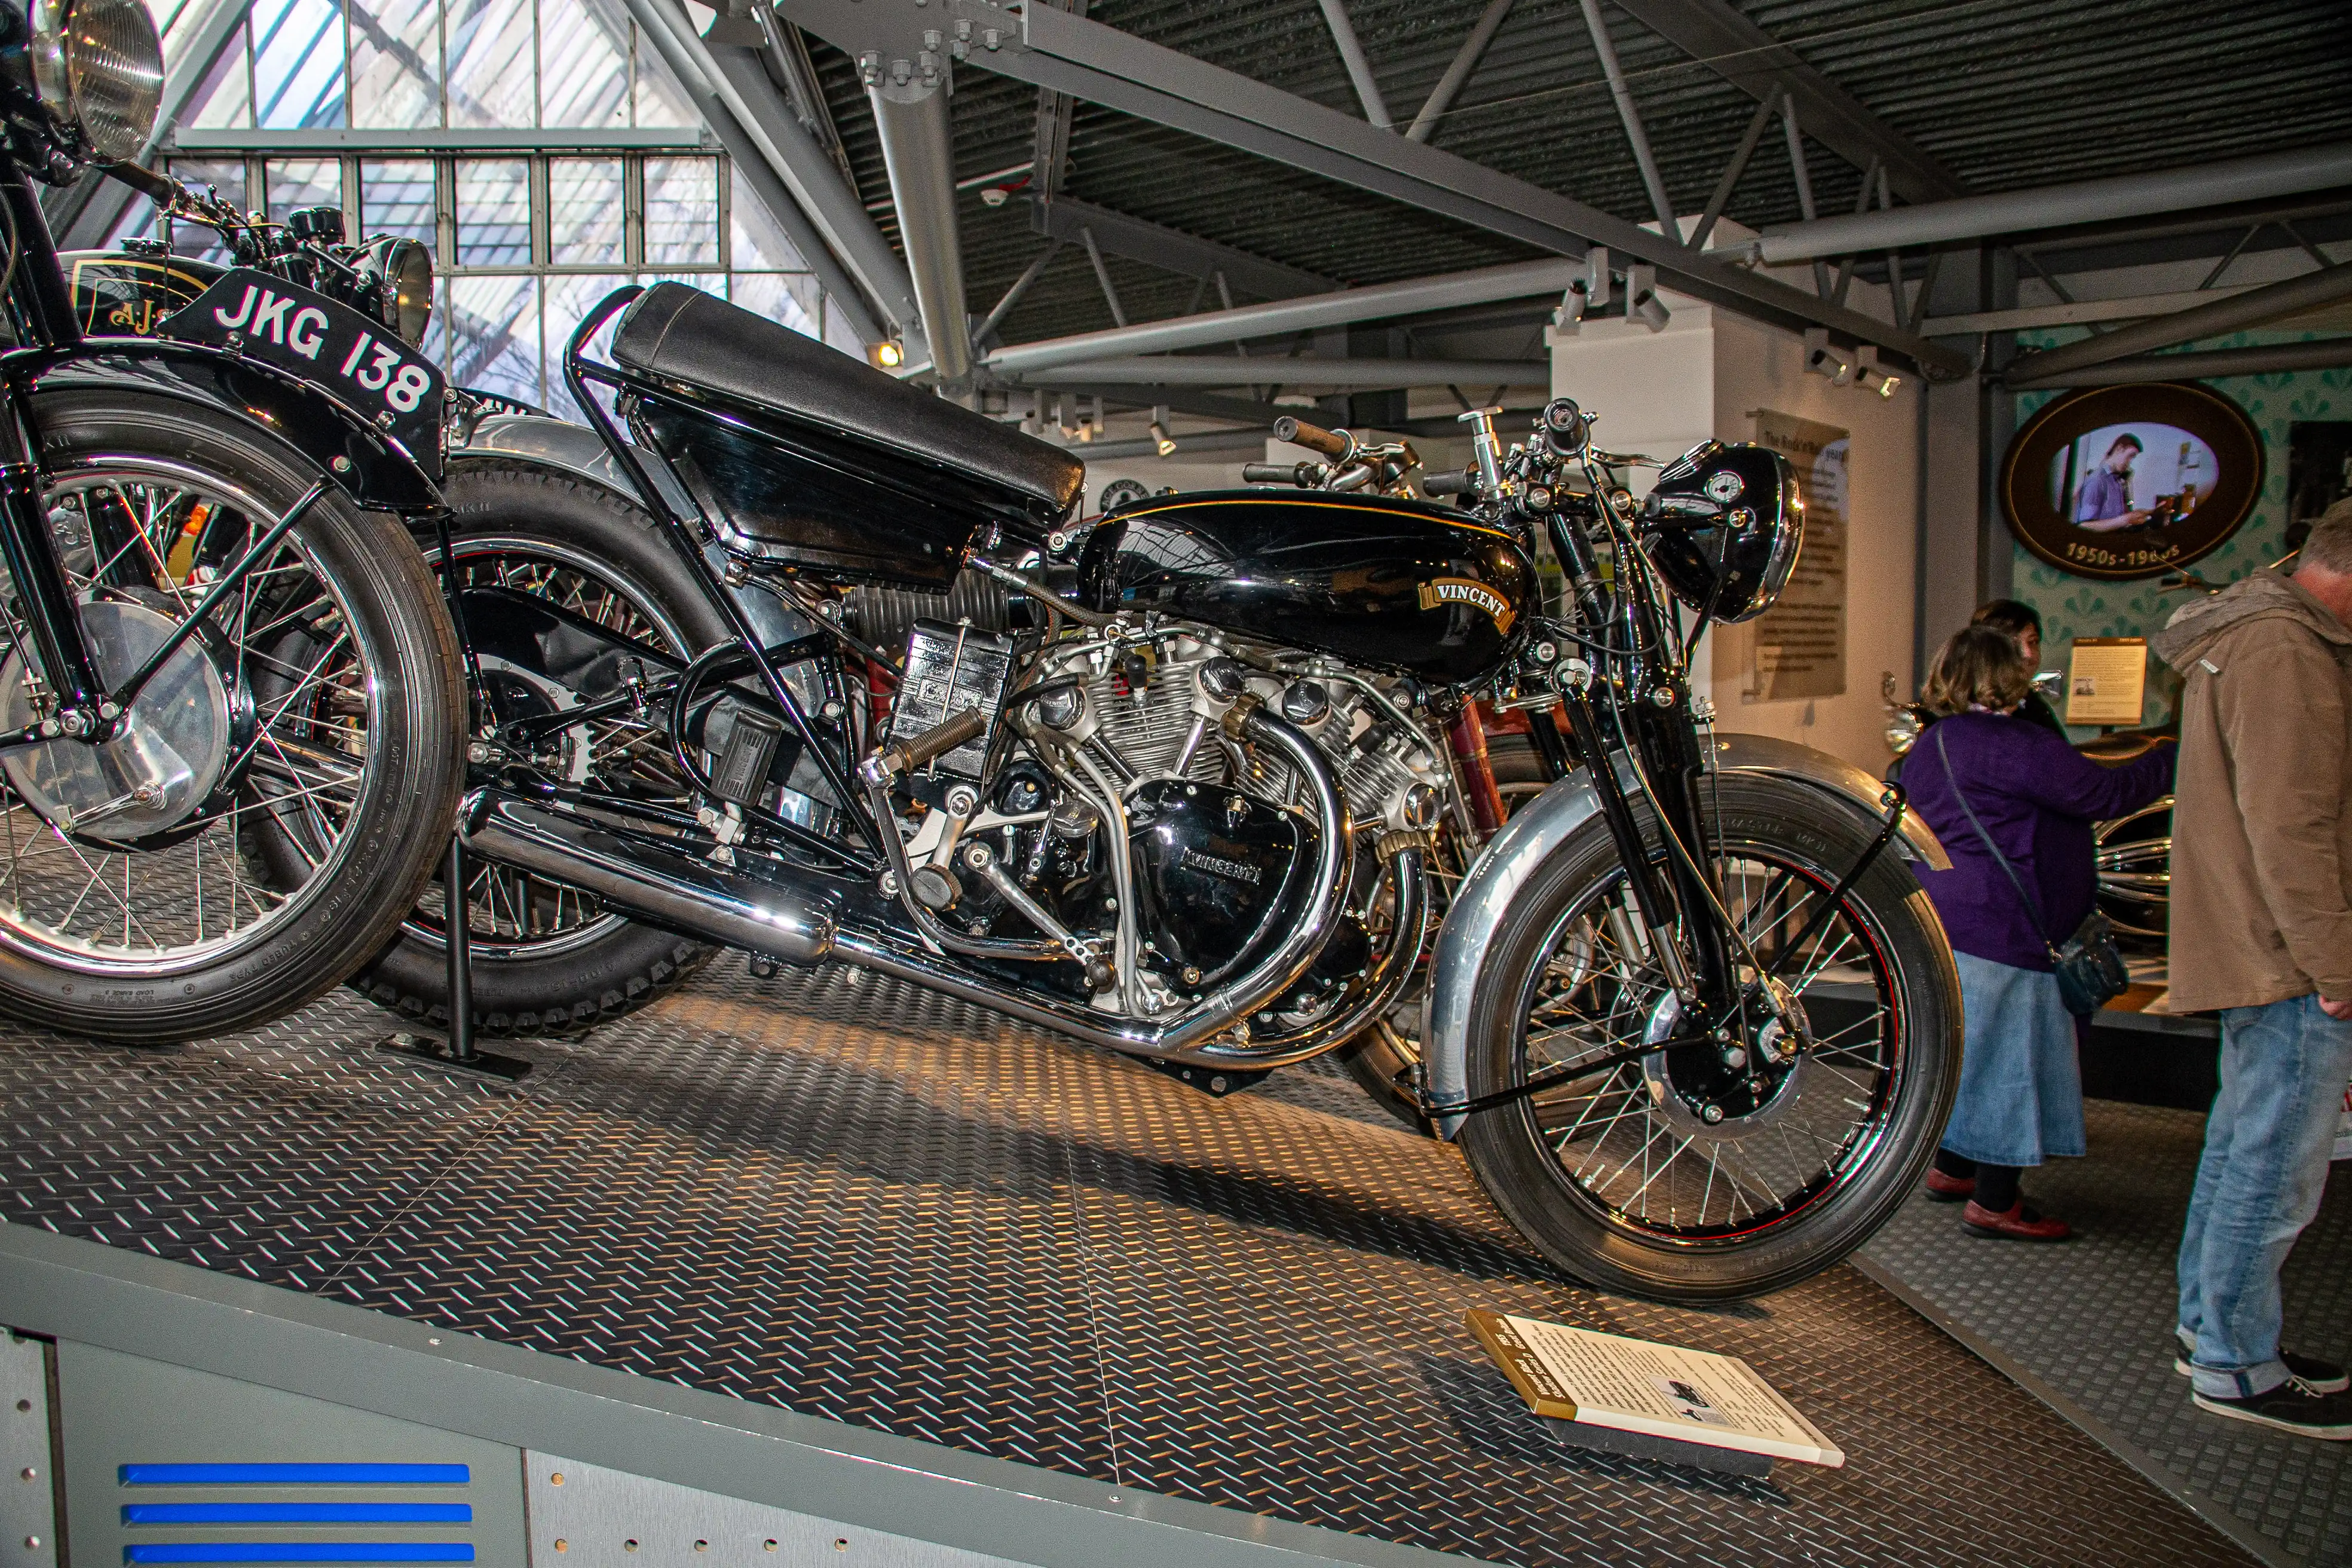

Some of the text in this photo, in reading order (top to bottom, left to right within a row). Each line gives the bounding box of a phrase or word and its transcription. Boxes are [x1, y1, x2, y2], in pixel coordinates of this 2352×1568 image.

[215, 284, 431, 413] JKG 138
[1437, 584, 1506, 617] VINCENT
[1190, 852, 1258, 883] VINCENT
[1515, 1358, 1551, 1395] Vincent Black
[1528, 1358, 1547, 1375] Series
[1542, 1374, 1566, 1398] Shadow
